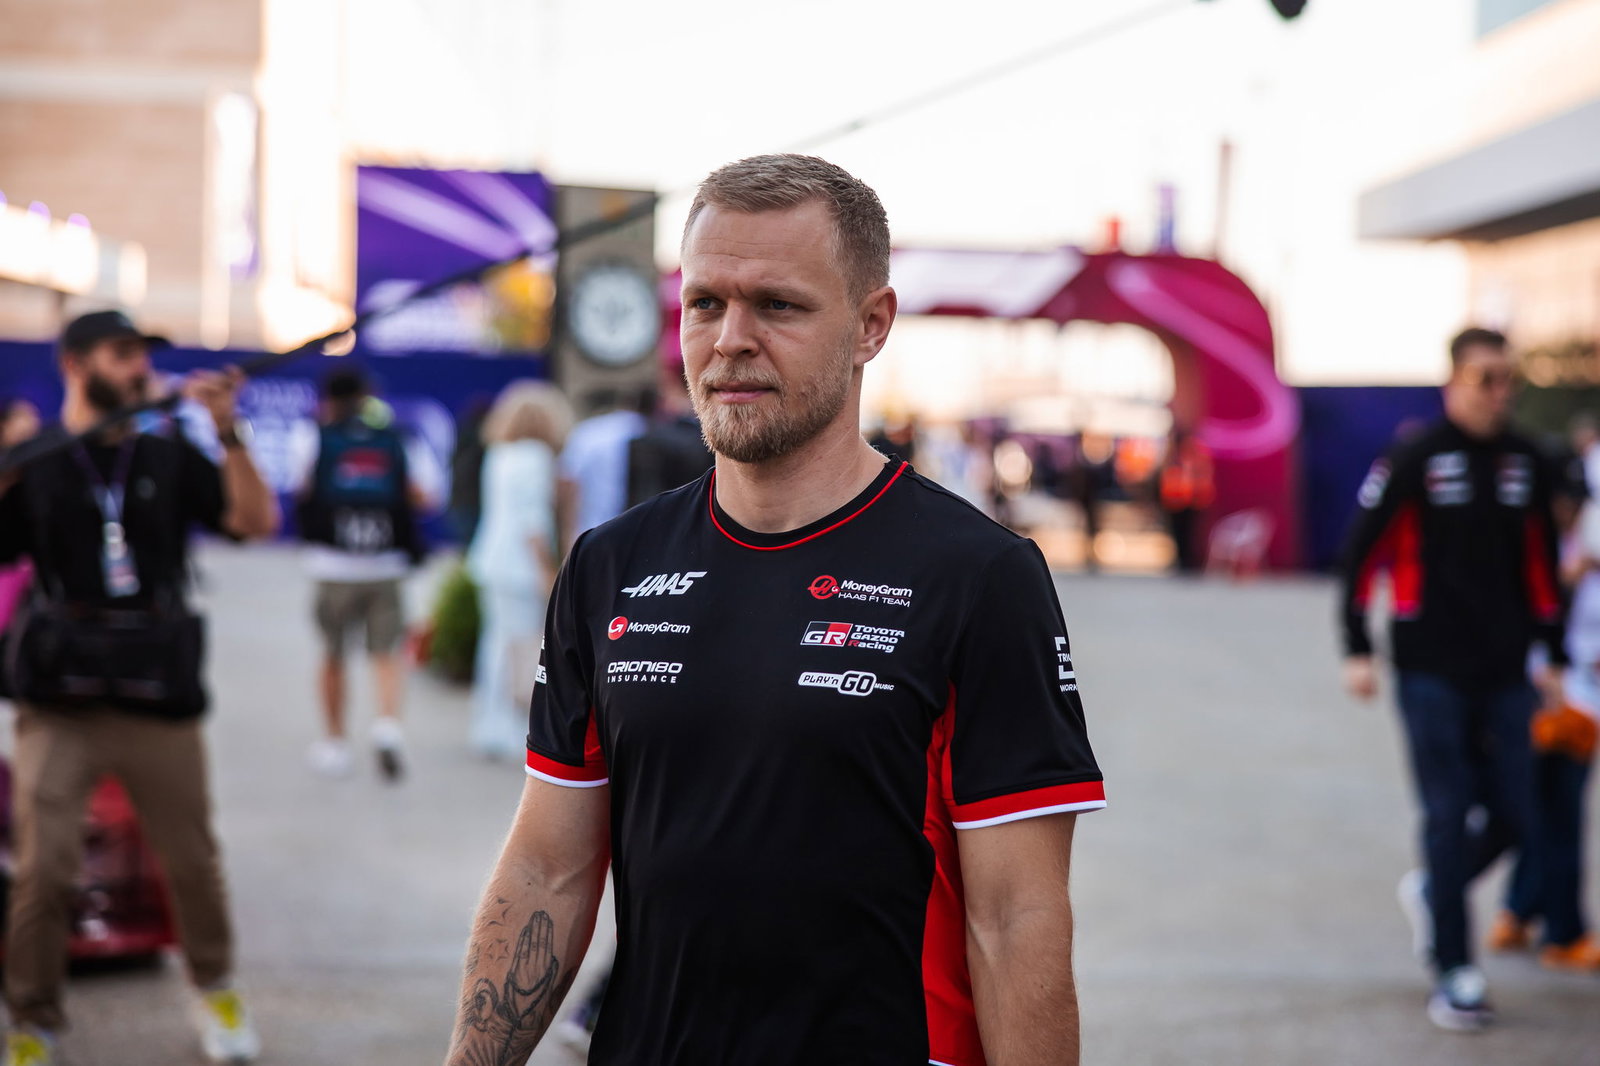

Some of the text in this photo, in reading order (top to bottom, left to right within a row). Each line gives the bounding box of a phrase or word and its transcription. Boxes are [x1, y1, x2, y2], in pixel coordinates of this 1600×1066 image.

[621, 571, 707, 598] HAAS
[841, 580, 912, 597] MoneyGram
[838, 592, 867, 601] HAAS
[882, 597, 911, 607] TEAM
[627, 622, 690, 634] MoneyGram
[854, 624, 905, 637] TOYOTA
[804, 631, 846, 645] GR
[850, 633, 899, 644] GAZOO
[847, 640, 895, 653] Racing
[607, 674, 677, 683] INSURANCE
[840, 673, 875, 694] GO
[874, 682, 894, 691] MUSIC
